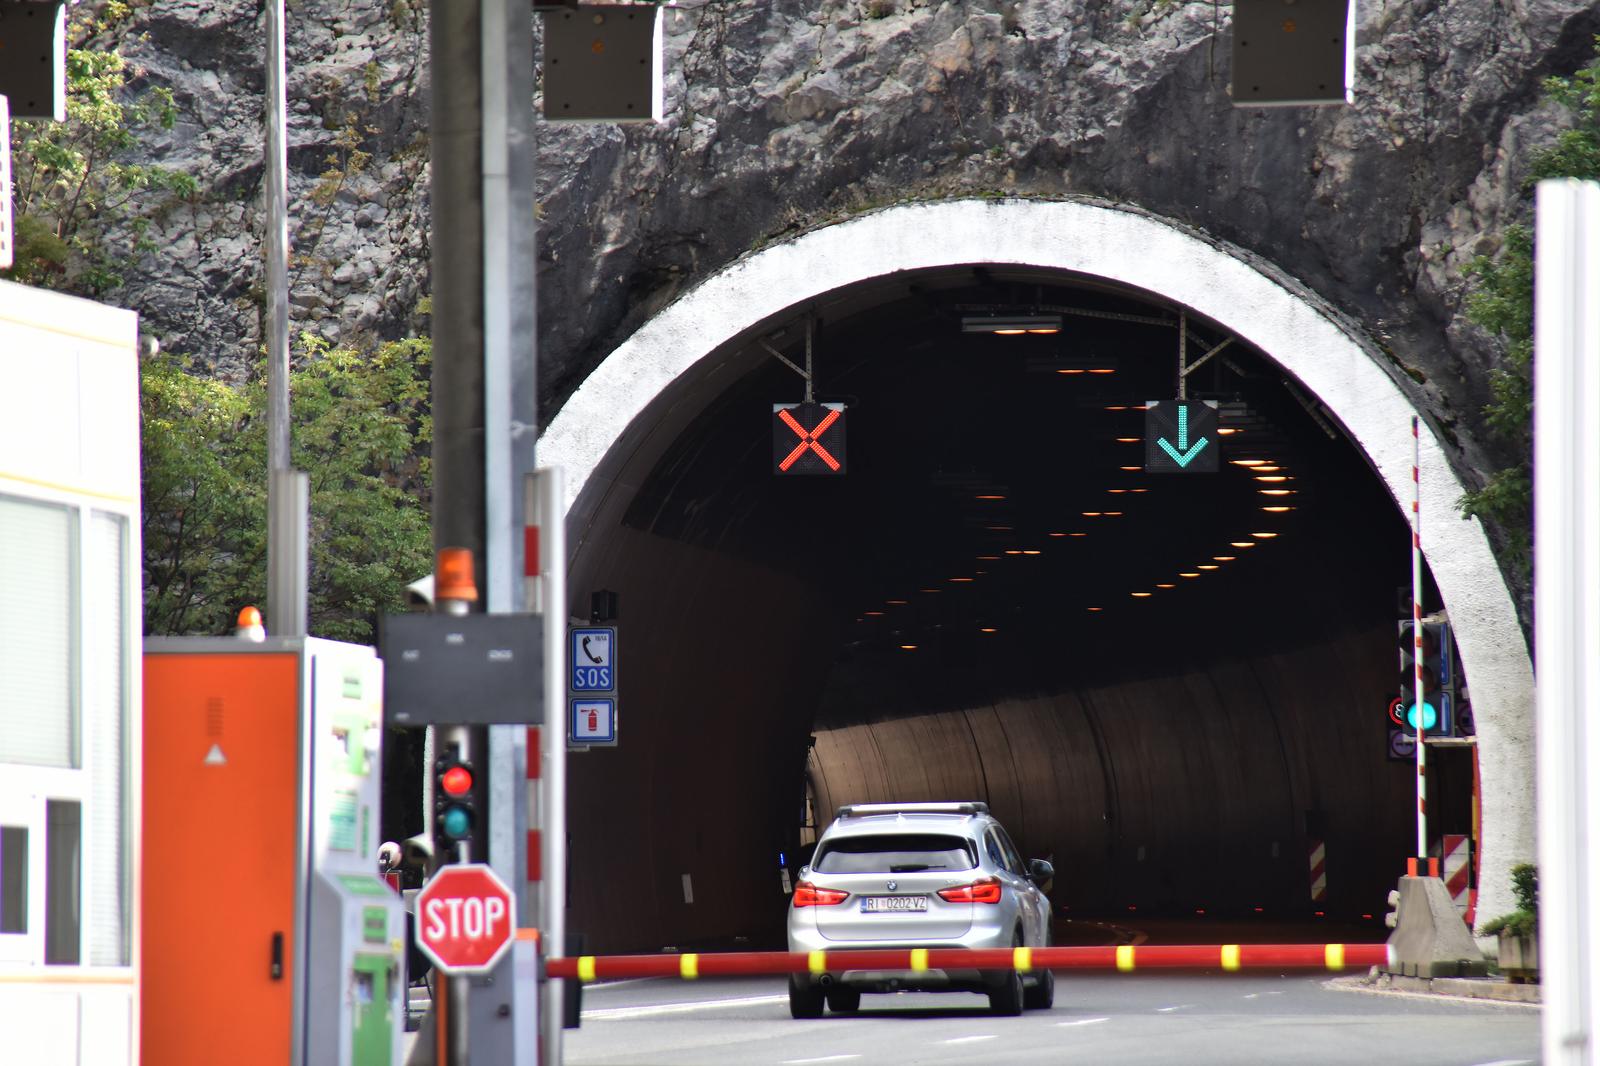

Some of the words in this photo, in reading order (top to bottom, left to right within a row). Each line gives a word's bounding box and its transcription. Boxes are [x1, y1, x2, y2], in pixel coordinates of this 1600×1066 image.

[576, 668, 609, 687] SOS
[868, 898, 879, 909] RI
[426, 896, 504, 941] STOP
